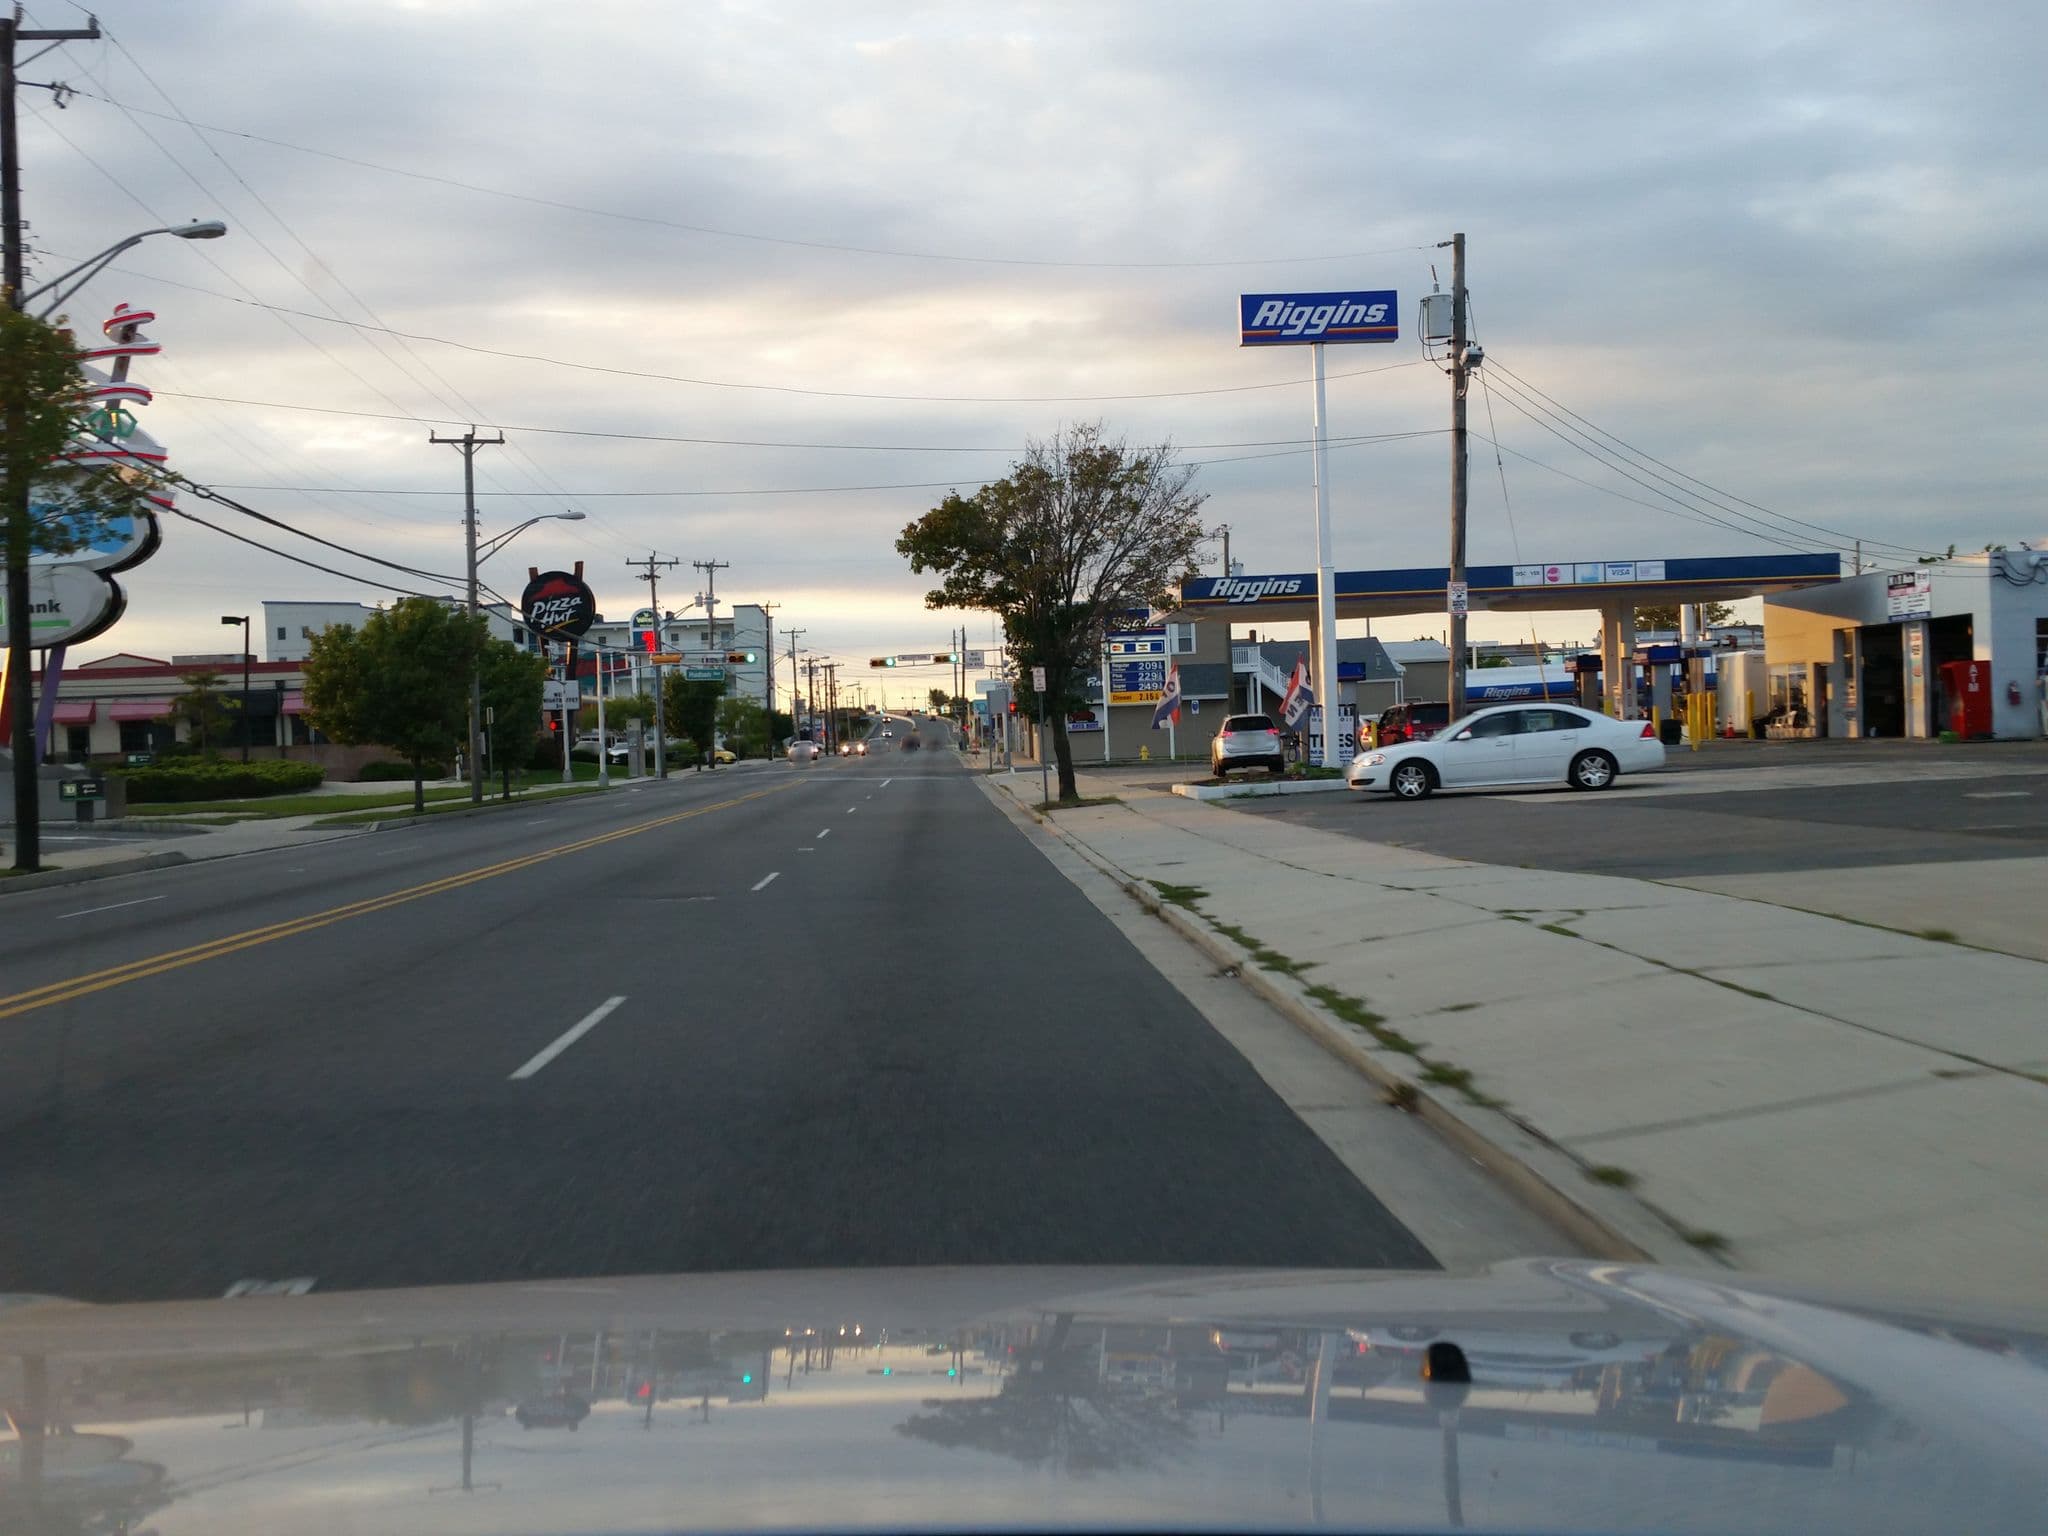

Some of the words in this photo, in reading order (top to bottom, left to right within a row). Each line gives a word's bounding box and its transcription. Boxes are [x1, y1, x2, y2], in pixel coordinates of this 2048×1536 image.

[1251, 300, 1389, 336] Riggins
[1611, 568, 1630, 576] VISA
[1209, 577, 1302, 603] Riggins
[28, 599, 62, 614] ank
[530, 596, 583, 624] Pizza
[541, 608, 577, 629] Hut
[1138, 662, 1158, 670] 209
[1138, 672, 1158, 681] 229
[1483, 687, 1531, 700] Riggins
[1310, 733, 1354, 748] TIES
